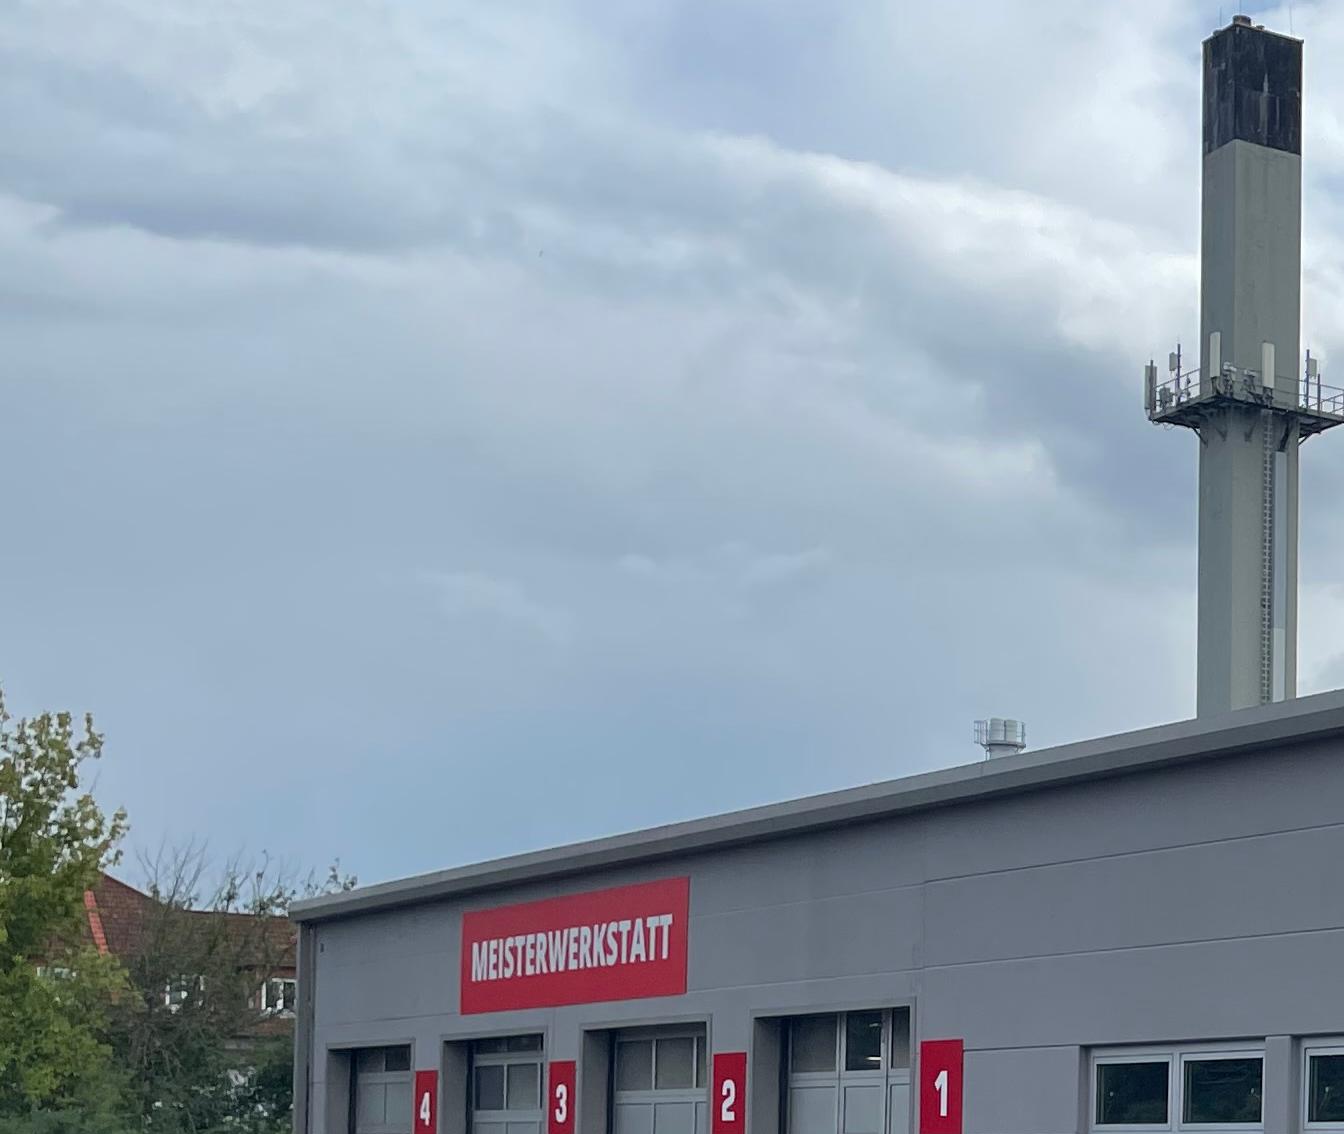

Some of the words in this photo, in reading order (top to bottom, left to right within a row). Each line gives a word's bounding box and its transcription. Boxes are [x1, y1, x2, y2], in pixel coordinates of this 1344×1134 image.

[472, 914, 673, 982] MEISTERWERKSTATT
[420, 1092, 430, 1125] 4
[555, 1084, 567, 1123] 3
[722, 1079, 735, 1121] 2
[934, 1071, 948, 1116] 1
